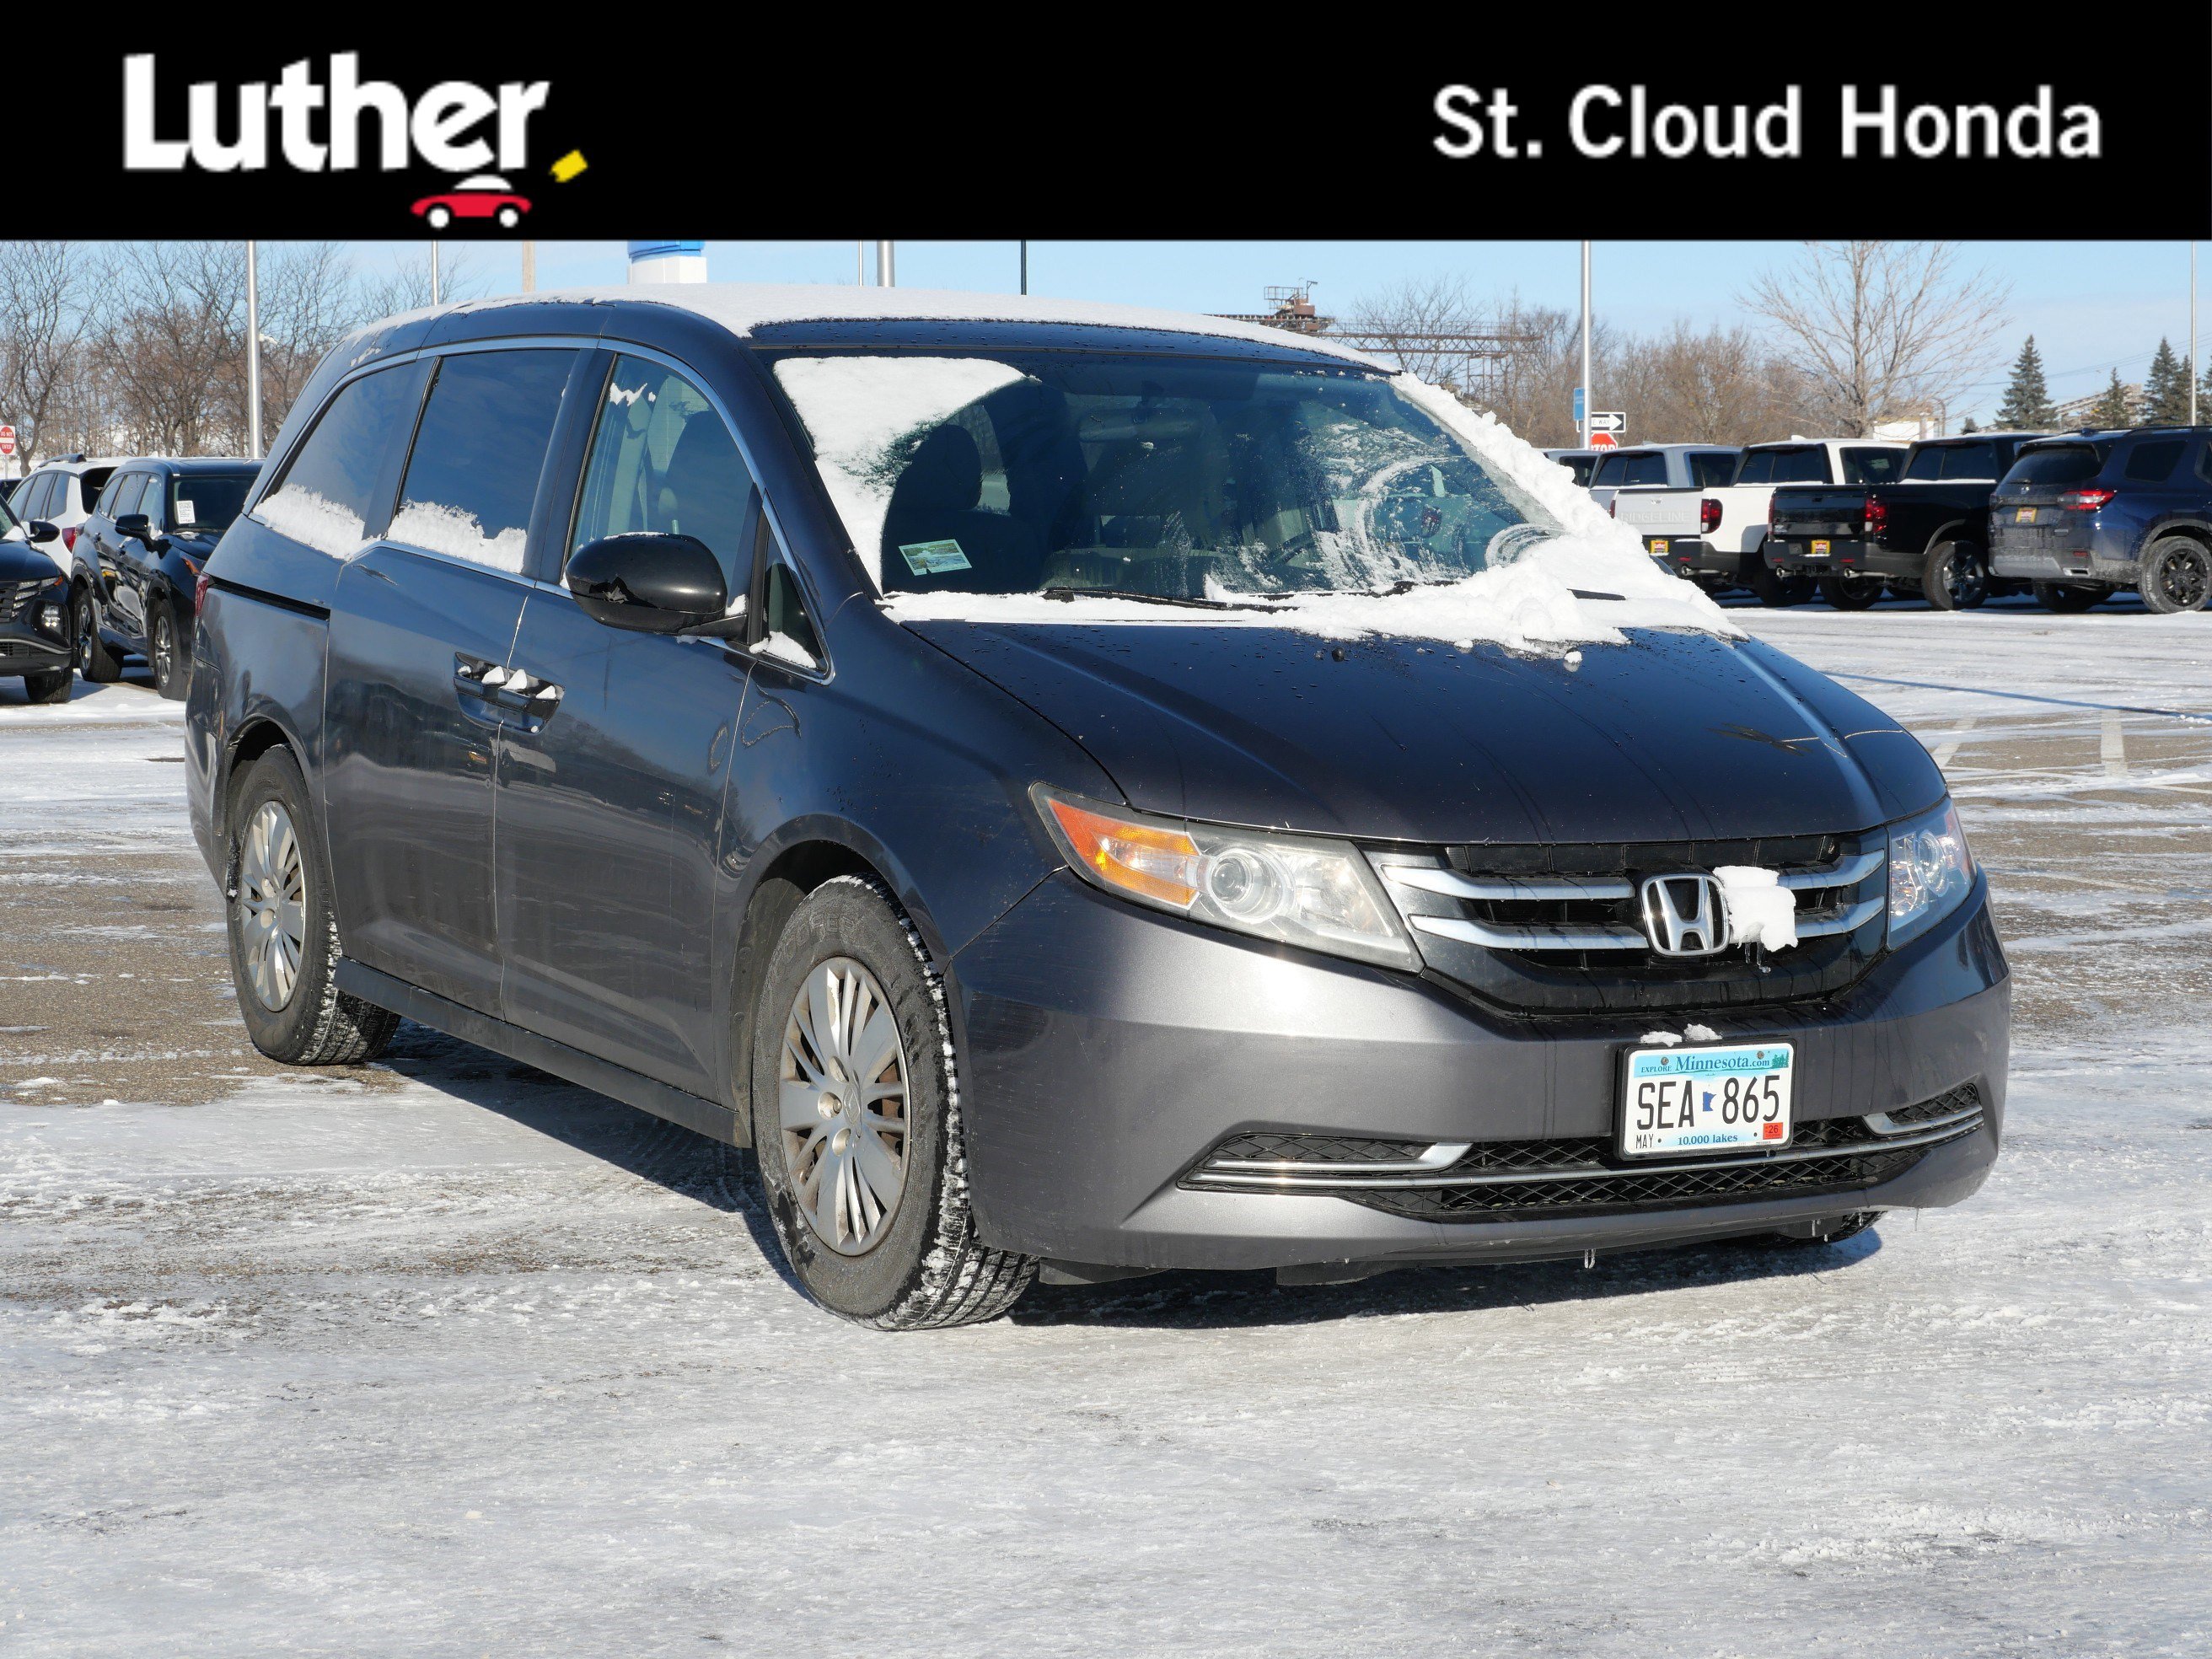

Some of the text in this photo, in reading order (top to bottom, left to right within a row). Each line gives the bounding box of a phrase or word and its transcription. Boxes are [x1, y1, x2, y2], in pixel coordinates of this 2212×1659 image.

[1620, 512, 1694, 522] RIDGELINE
[1675, 1055, 1770, 1071] Minnesota.com
[1636, 1075, 1780, 1130] SEA 865
[1769, 1125, 1779, 1134] 26
[1635, 1133, 1654, 1149] MAY
[1678, 1134, 1738, 1146] 10,000 lakes
